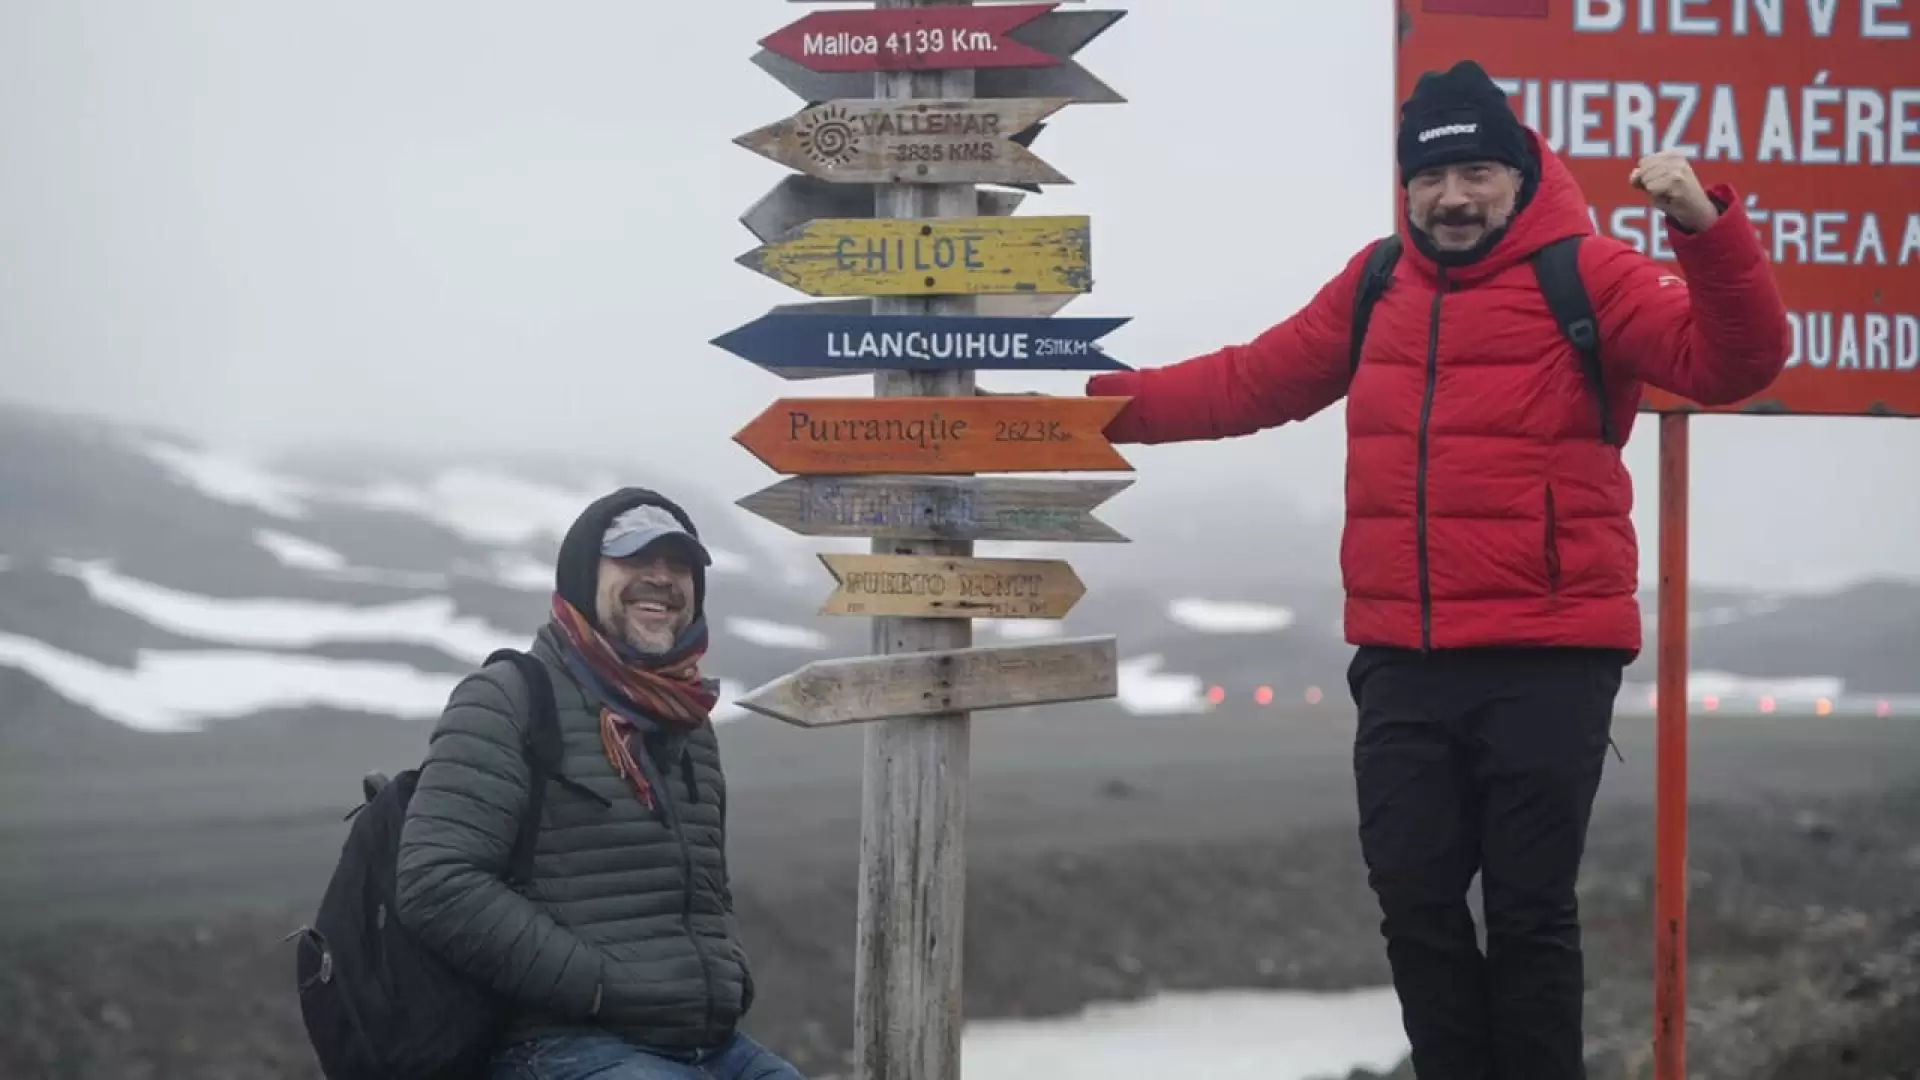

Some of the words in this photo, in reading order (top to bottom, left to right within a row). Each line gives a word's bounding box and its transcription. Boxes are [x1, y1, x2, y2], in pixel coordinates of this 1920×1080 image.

[803, 32, 878, 56] Malloa
[884, 29, 944, 55] 4139
[951, 28, 998, 52] Km.
[861, 113, 999, 136] VALLENAR
[1492, 78, 1743, 160] UERZA
[948, 142, 994, 161] KMS
[836, 235, 985, 273] CHILOE
[827, 331, 1029, 360] LLANQUIHUE
[846, 571, 946, 596] PUERTO
